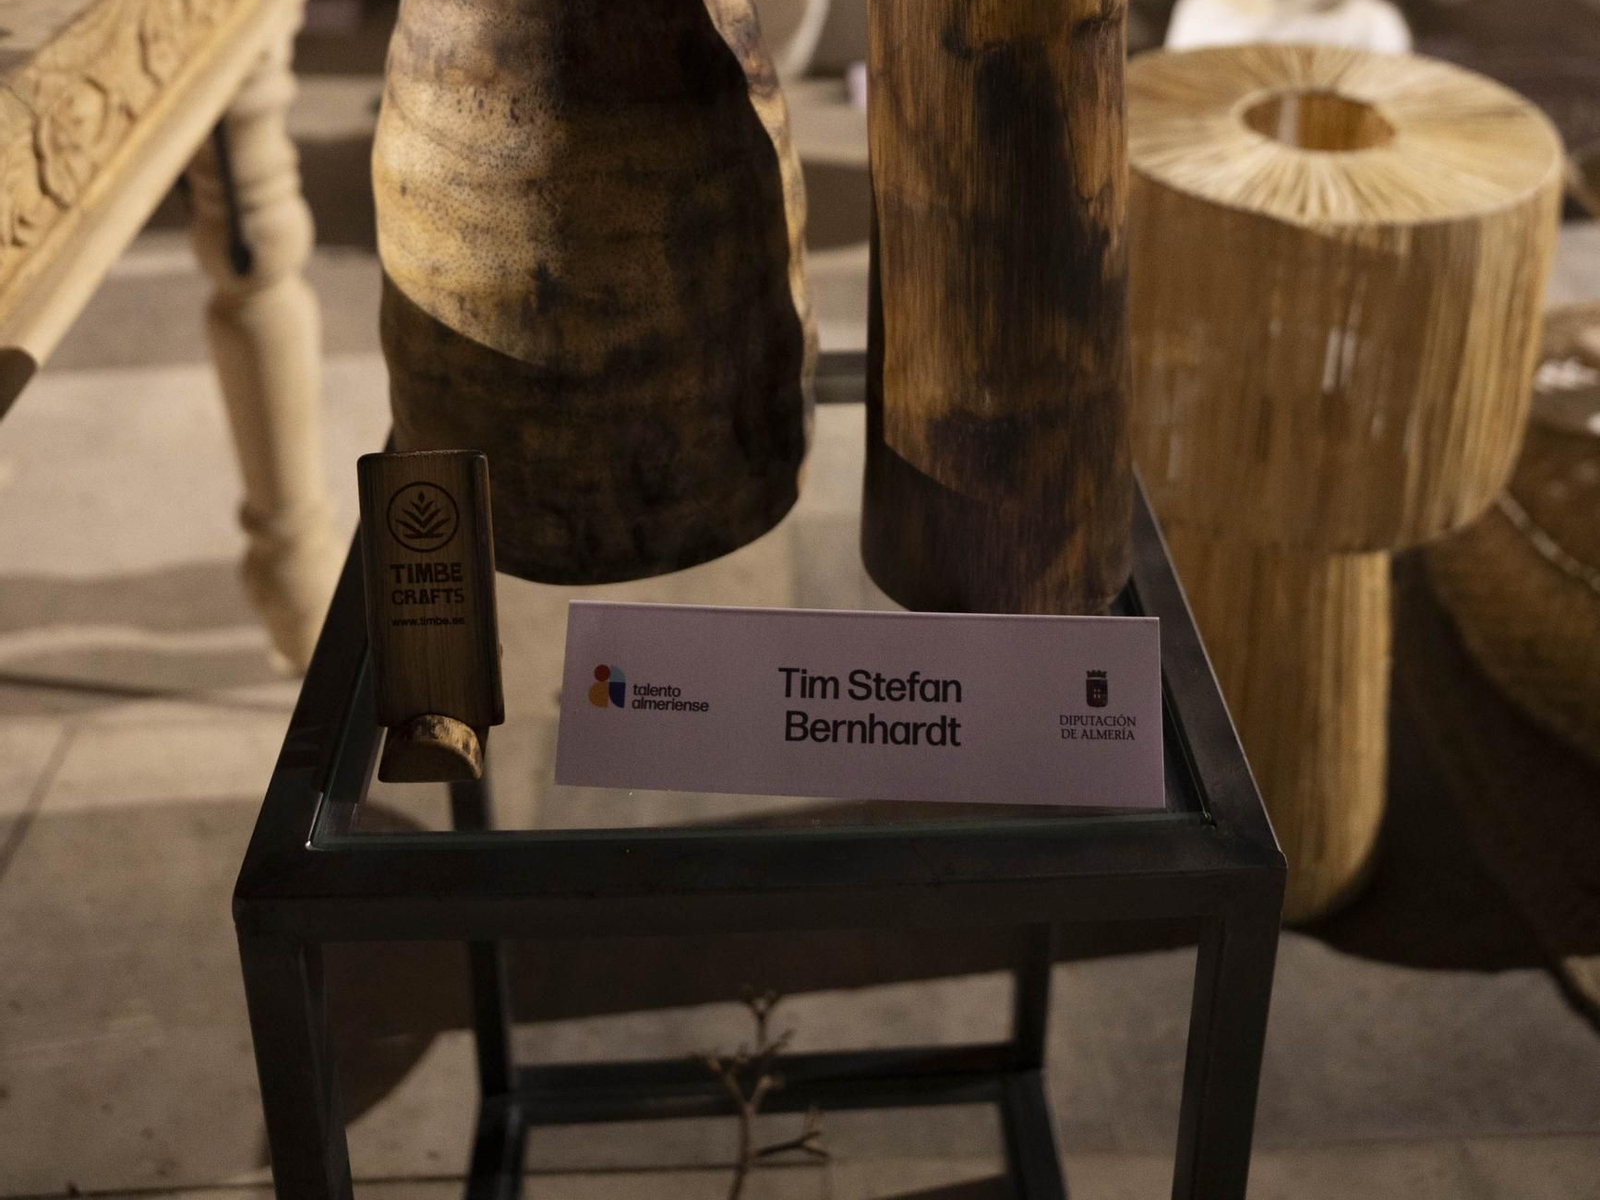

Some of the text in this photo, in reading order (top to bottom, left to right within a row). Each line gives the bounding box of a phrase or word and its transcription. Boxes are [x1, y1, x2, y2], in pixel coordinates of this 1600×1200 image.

[389, 563, 463, 584] TIMBE
[391, 588, 465, 605] CRAFTS
[391, 616, 465, 626] www.timbe.es
[632, 683, 681, 697] talento
[778, 667, 963, 703] Tim Stefan
[631, 697, 709, 712] almeriense
[1059, 714, 1137, 726] DIPUTACIÓN
[784, 710, 962, 747] Bernhardt
[1061, 727, 1135, 740] DE ALMERÍA
